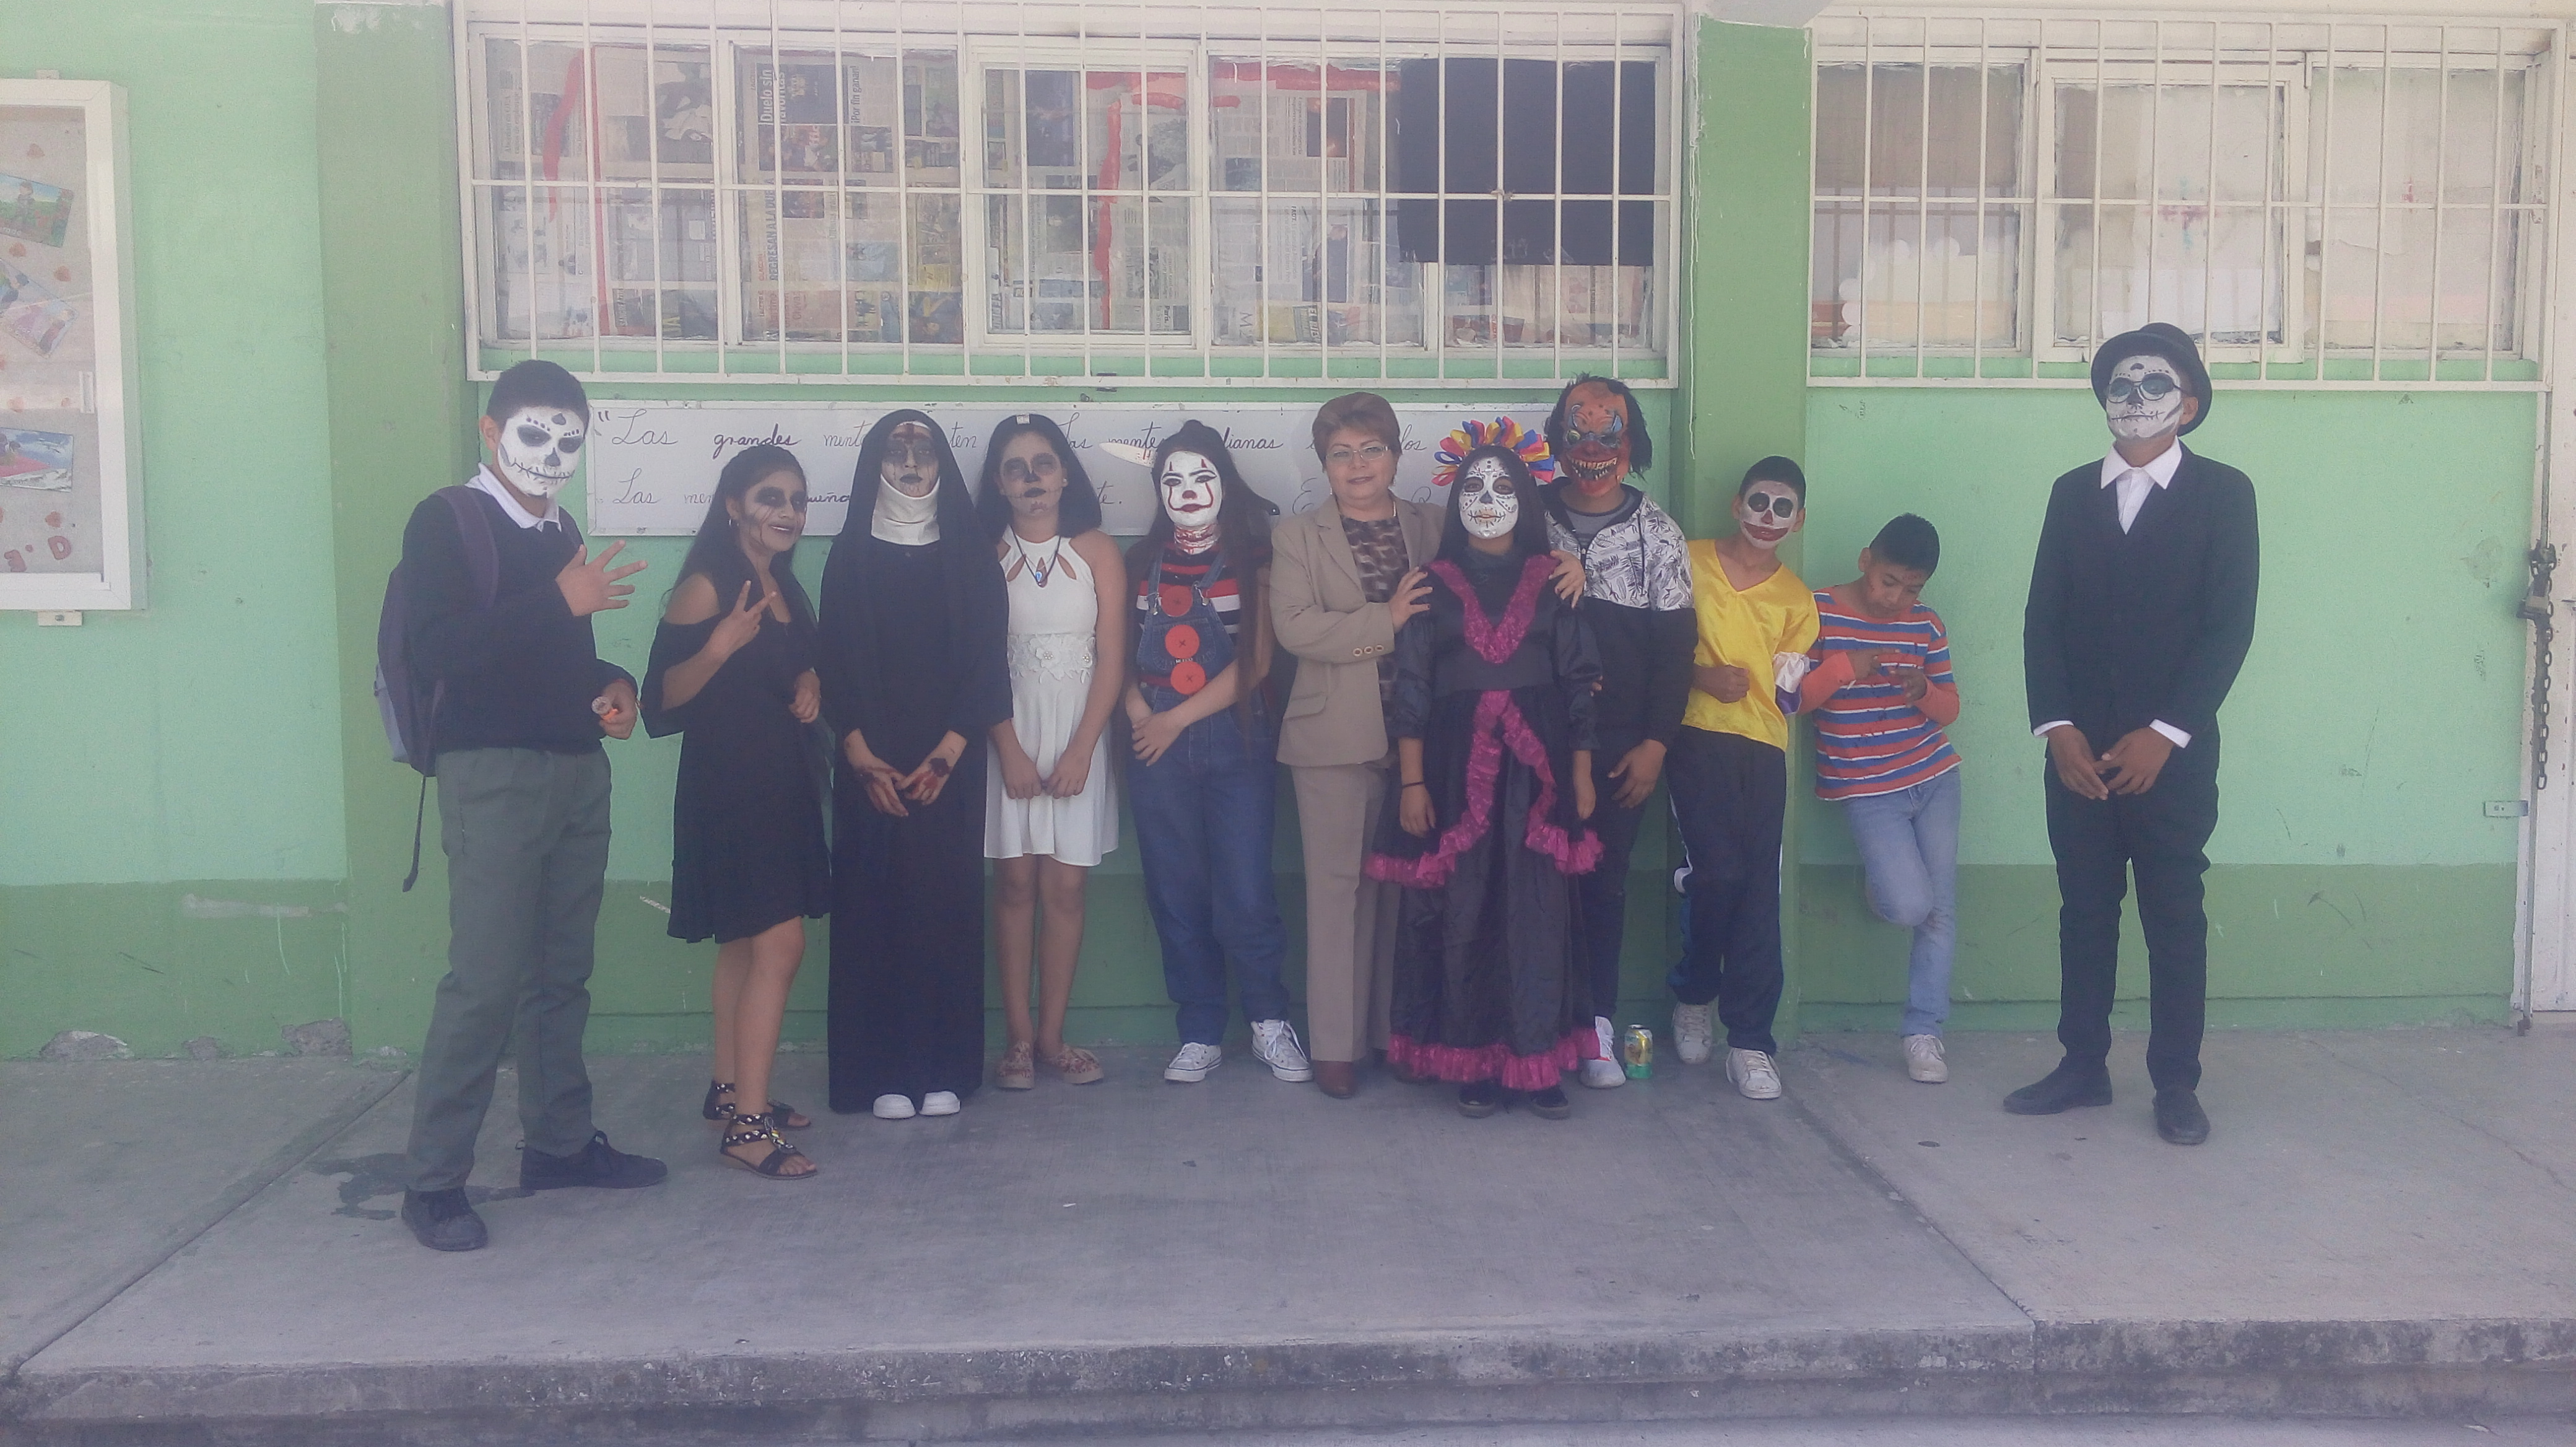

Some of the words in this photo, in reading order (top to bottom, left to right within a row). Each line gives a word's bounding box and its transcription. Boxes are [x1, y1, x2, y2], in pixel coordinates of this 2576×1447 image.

[760, 90, 773, 122] Duelo
[711, 422, 802, 460] grandes
[949, 422, 977, 448] ten
[1108, 421, 1165, 450] mente
[612, 468, 660, 504] Las
[805, 491, 850, 504] ueña
